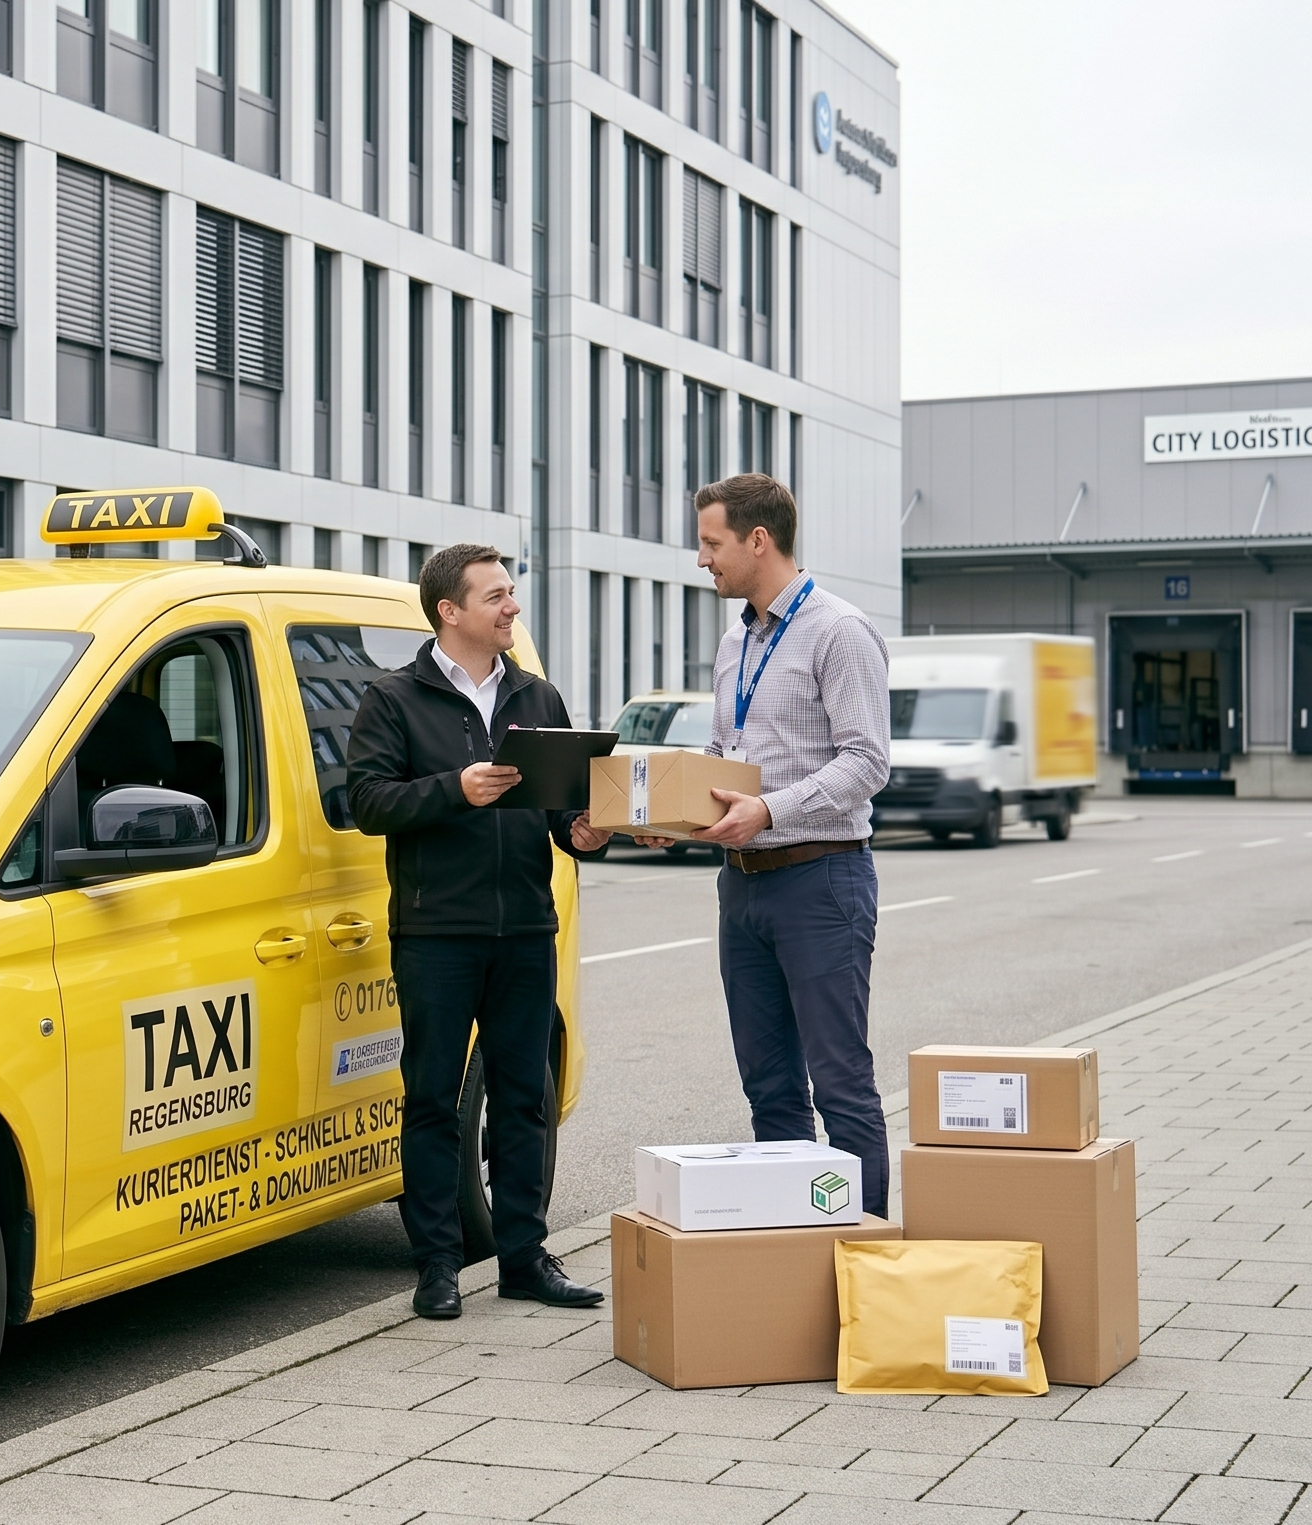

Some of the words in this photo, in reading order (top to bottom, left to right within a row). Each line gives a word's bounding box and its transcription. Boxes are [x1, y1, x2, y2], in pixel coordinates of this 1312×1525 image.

[1152, 430, 1202, 453] CITY
[68, 495, 174, 529] TAXI
[1167, 579, 1188, 596] 16
[356, 977, 397, 1015] 0176
[130, 992, 252, 1093] TAXI
[129, 1081, 252, 1137] REGENSBURG
[116, 1137, 262, 1212] KURIERDIENST
[274, 1111, 352, 1163] SCHNELL
[355, 1106, 367, 1137] &
[179, 1184, 245, 1236] PAKET-
[249, 1180, 261, 1213] &
[266, 1135, 401, 1207] DOKUMENTENTR
